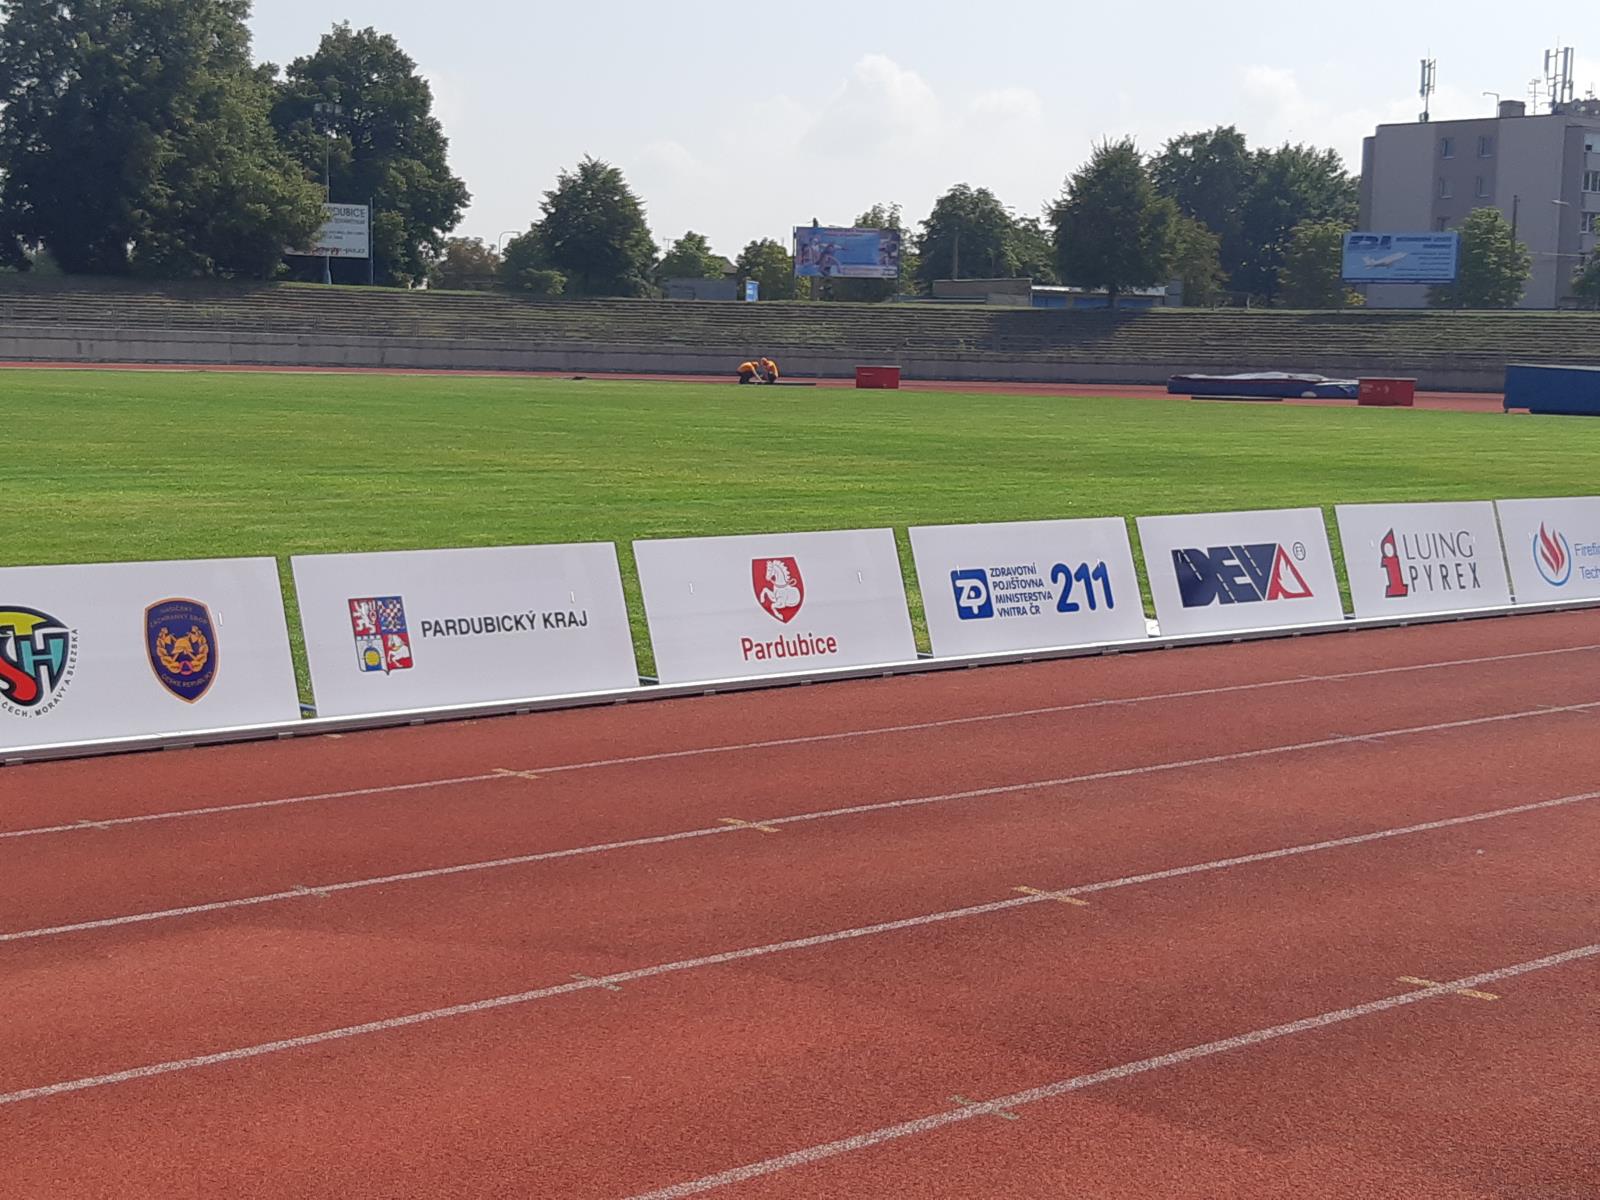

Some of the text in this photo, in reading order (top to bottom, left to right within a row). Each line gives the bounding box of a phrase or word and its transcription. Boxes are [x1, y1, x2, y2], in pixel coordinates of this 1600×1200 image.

[1402, 530, 1474, 560] LUING
[1574, 542, 1600, 557] Firefi
[989, 562, 1037, 578] ZDRAVOTNÍ
[992, 577, 1045, 591] POJIŠŤOVNA
[1171, 543, 1314, 608] DEVA
[1409, 562, 1481, 592] PYREX
[995, 591, 1053, 604] MINISTERSTVA
[1050, 561, 1114, 613] 211
[421, 610, 589, 638] PARDUBICKÝ KRAJ
[997, 603, 1041, 618] VNITRA ČR
[741, 633, 837, 661] Pardubice
